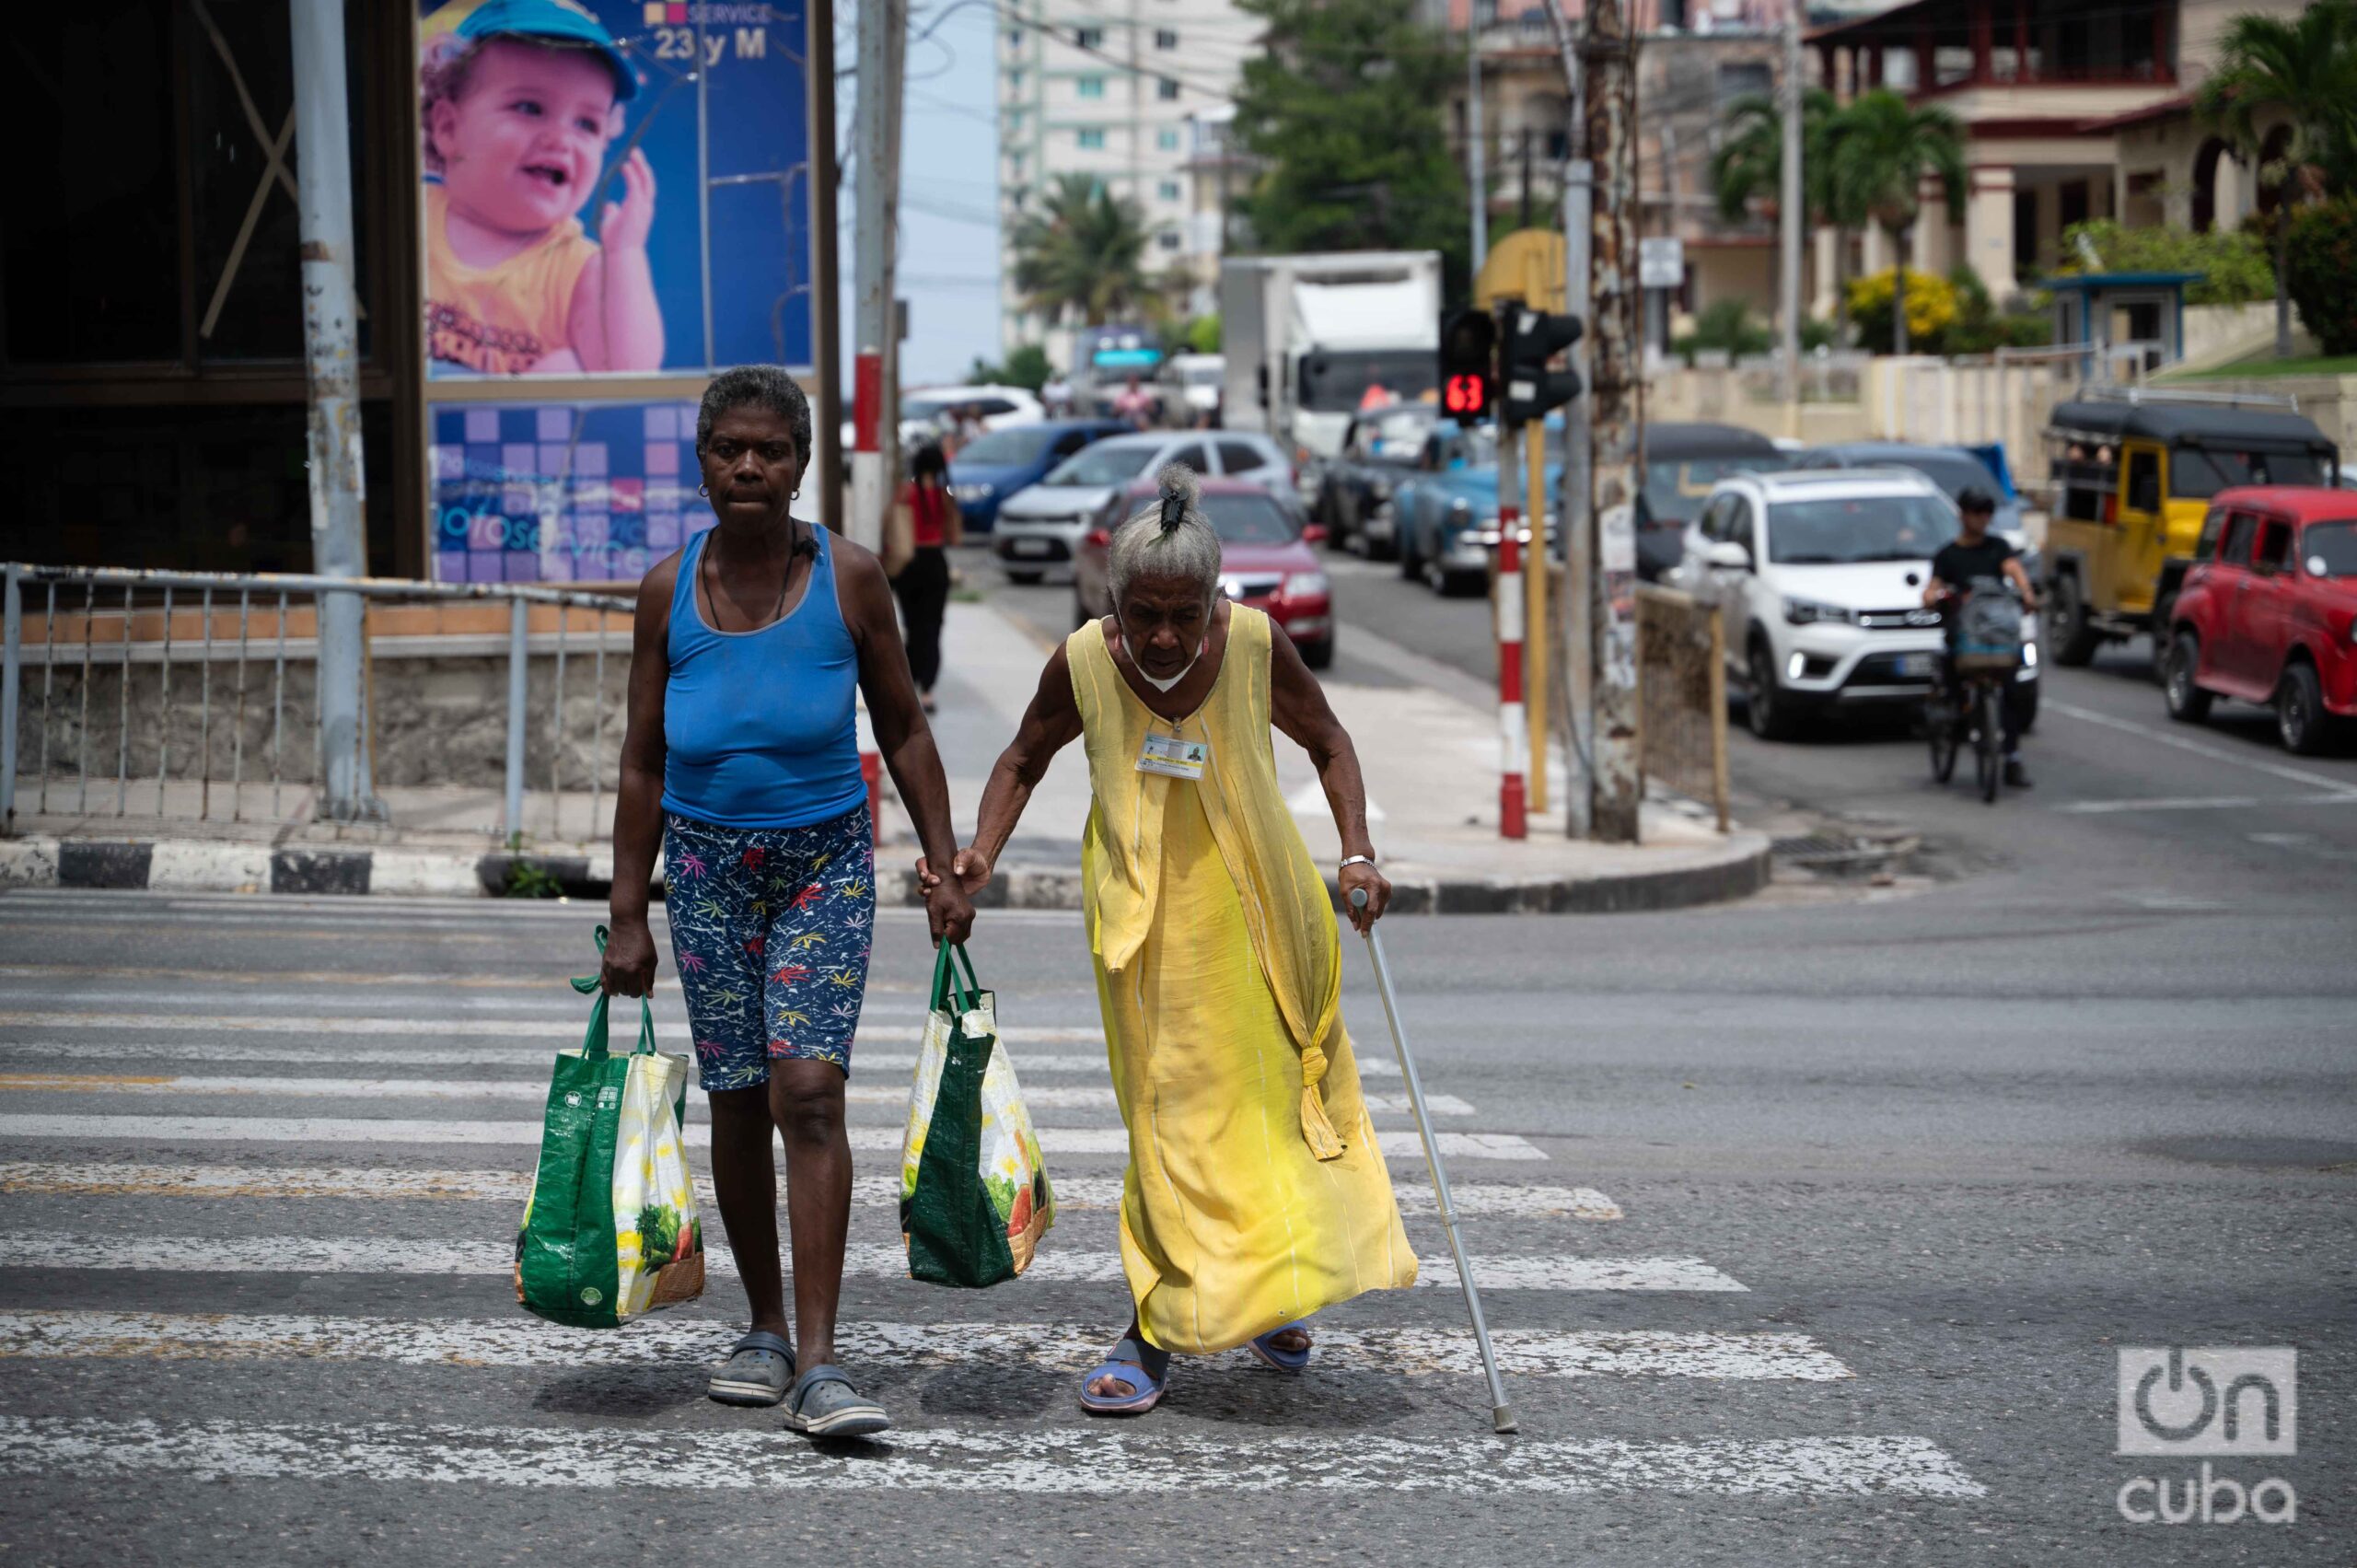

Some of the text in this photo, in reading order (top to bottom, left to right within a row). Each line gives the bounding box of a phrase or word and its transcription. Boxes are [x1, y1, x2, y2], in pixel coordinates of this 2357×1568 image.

[689, 4, 772, 24] SERVICE
[655, 27, 766, 66] 23 y M
[1446, 374, 1483, 412] 63
